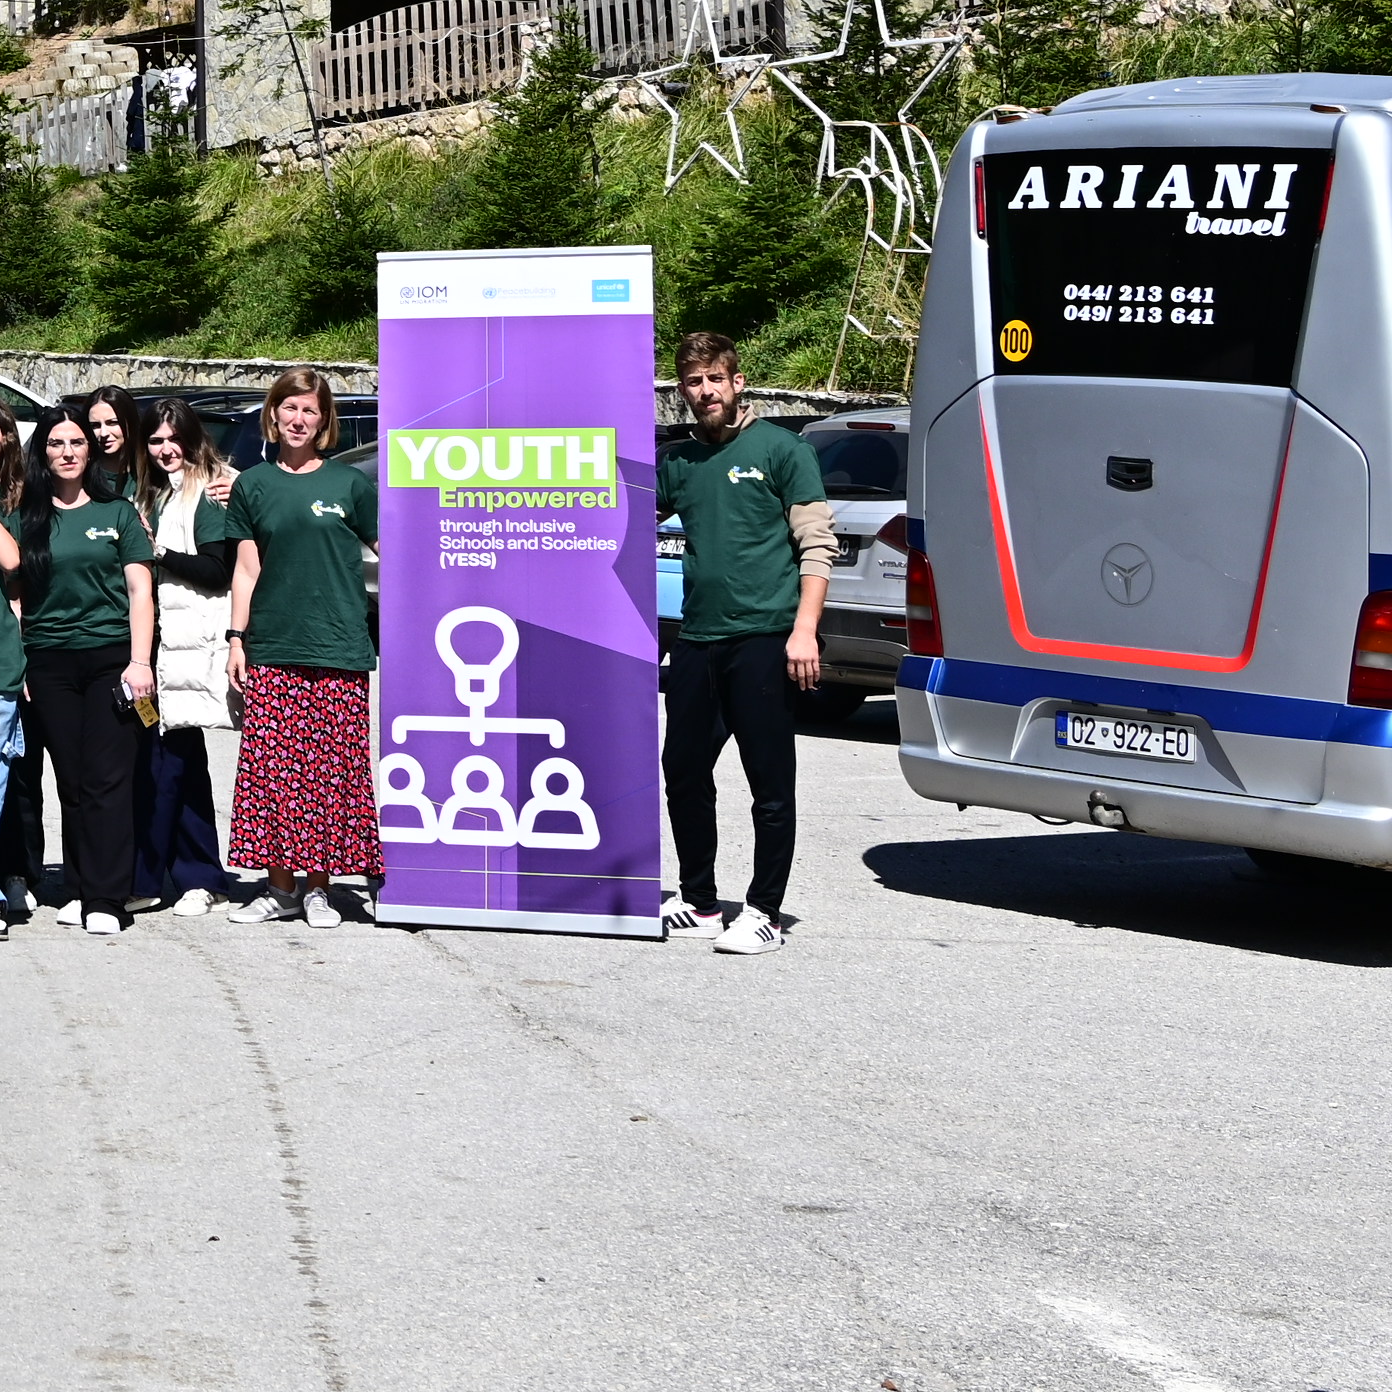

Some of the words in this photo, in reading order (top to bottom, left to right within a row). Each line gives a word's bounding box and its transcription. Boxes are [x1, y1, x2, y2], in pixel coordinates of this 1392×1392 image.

[1007, 164, 1298, 210] ARIANI
[1185, 211, 1287, 237] travel
[417, 285, 448, 299] IOM
[1118, 285, 1162, 302] 213
[1170, 287, 1214, 303] 641
[1118, 306, 1162, 323] 213
[1170, 308, 1214, 325] 641
[1002, 327, 1029, 354] 100
[396, 435, 608, 481] YOUTH
[438, 485, 617, 513] Empowered
[439, 518, 503, 536] through
[505, 518, 576, 533] Inclusive
[439, 535, 505, 550] Schools
[507, 535, 538, 550] and
[541, 535, 617, 551] Societies
[439, 551, 497, 569] (YESS)
